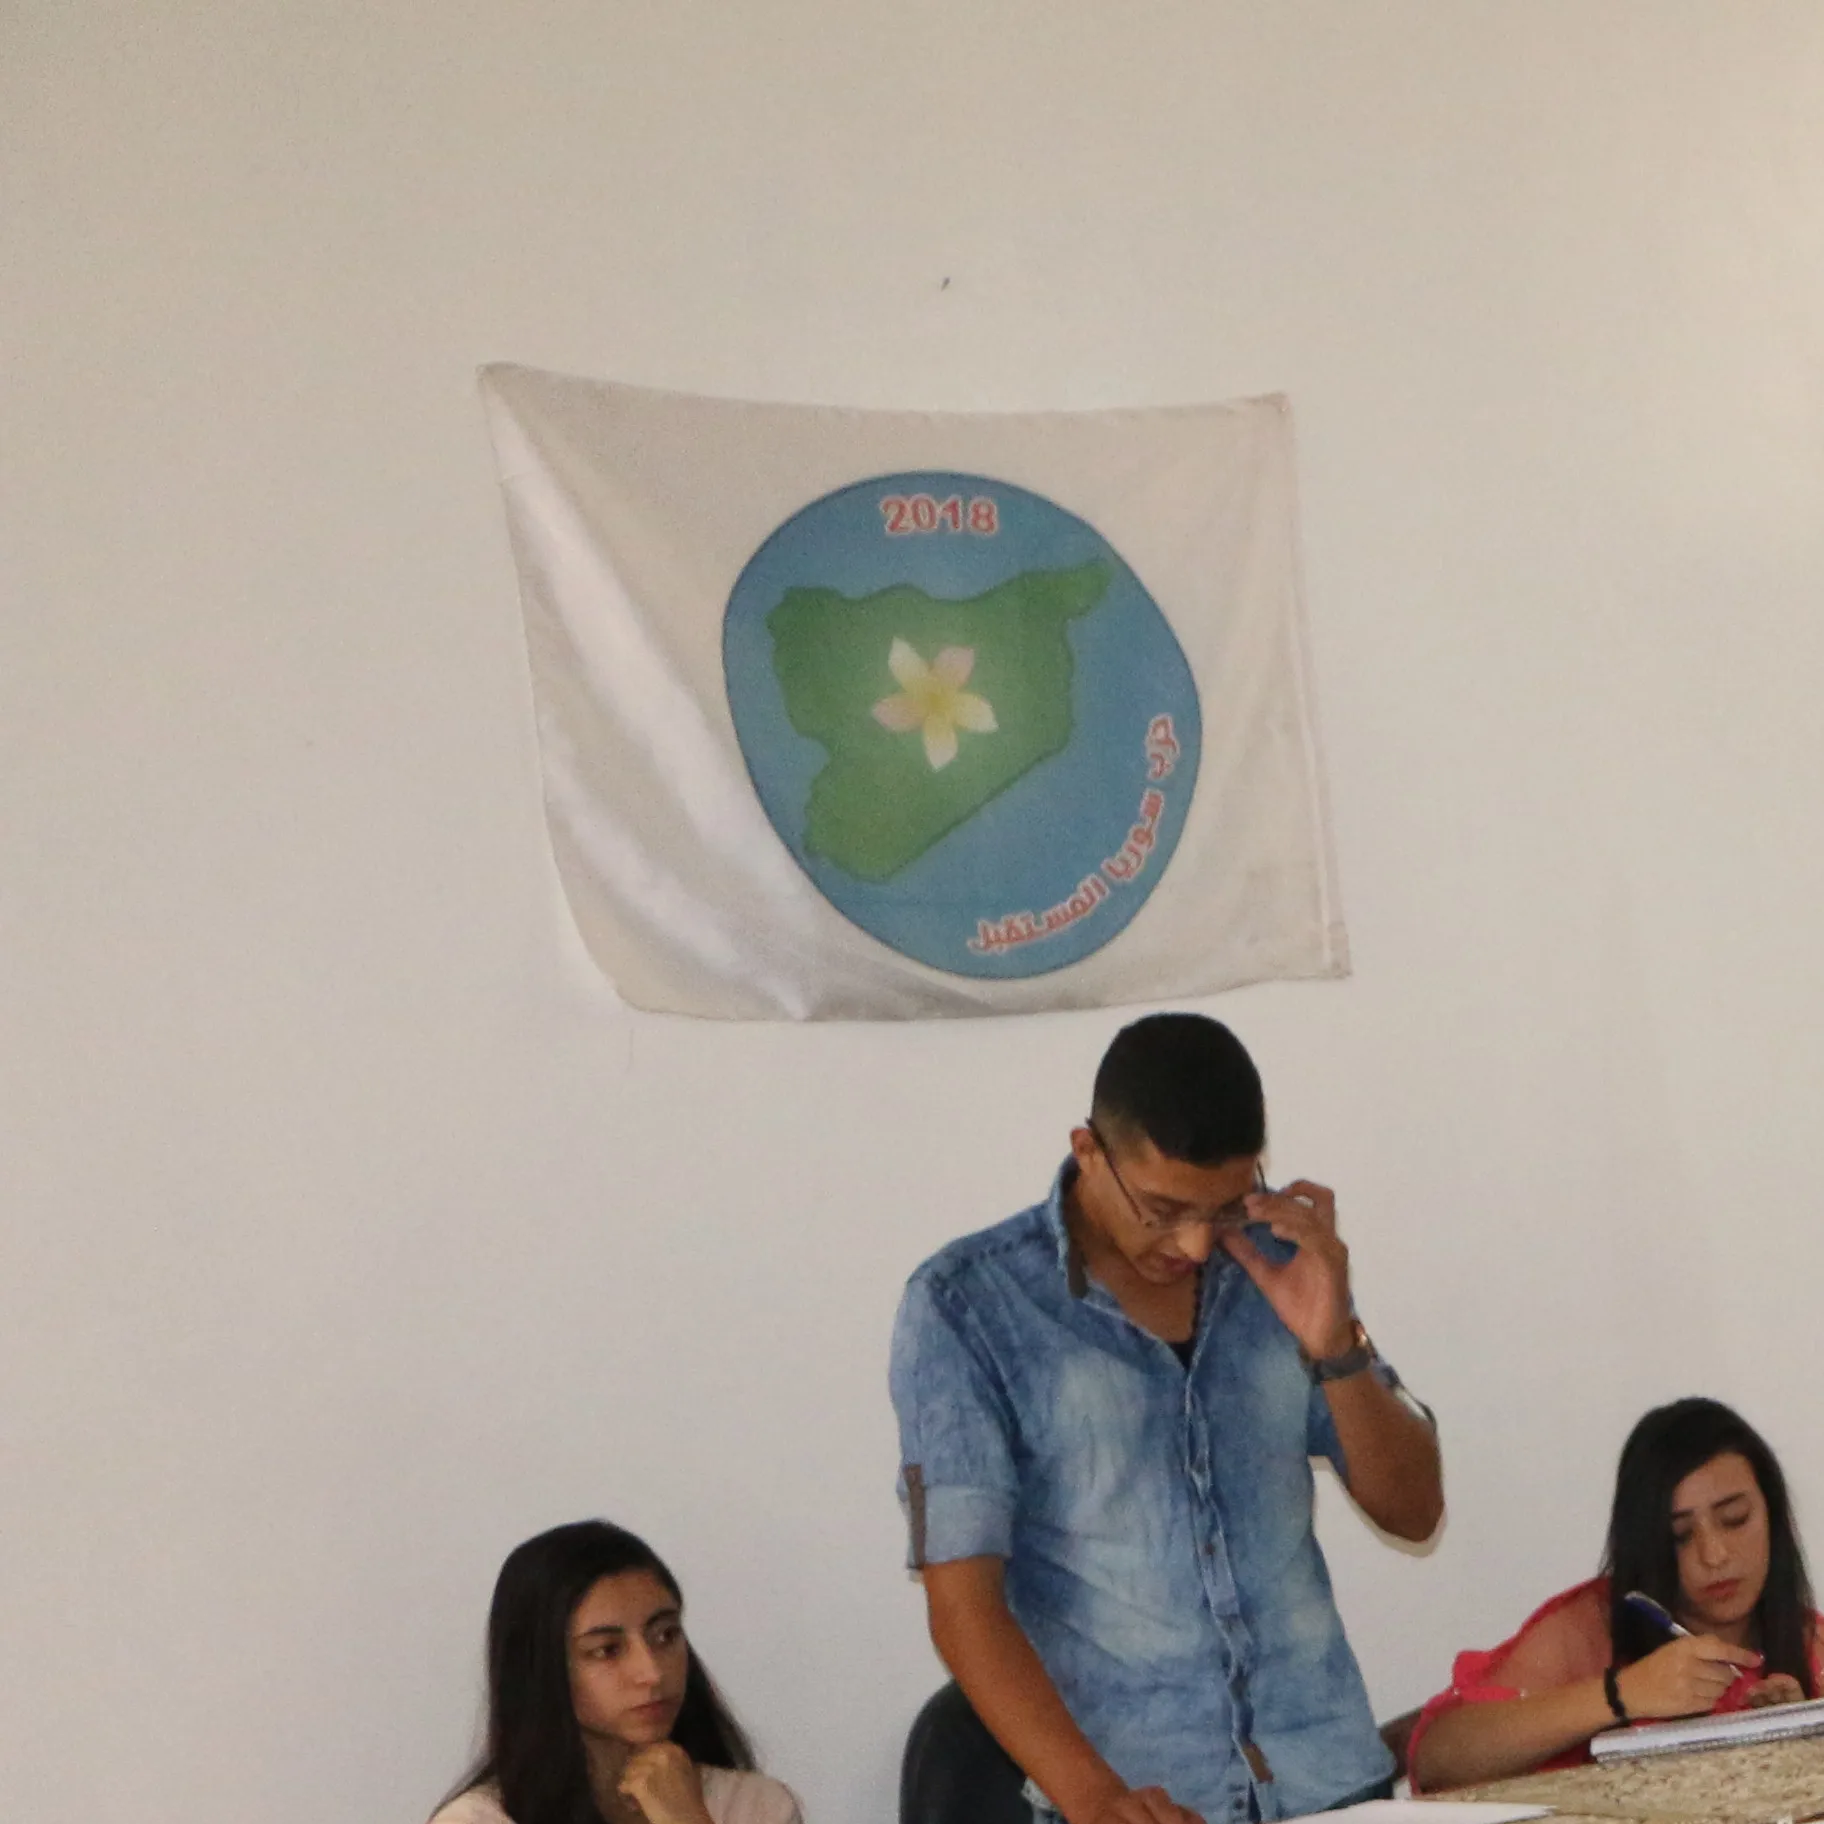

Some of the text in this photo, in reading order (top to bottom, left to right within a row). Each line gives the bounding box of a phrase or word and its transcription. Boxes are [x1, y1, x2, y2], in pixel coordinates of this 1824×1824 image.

[880, 493, 998, 536] 2018
[1100, 787, 1164, 882] سوريا
[966, 873, 1110, 956] المستقبل
